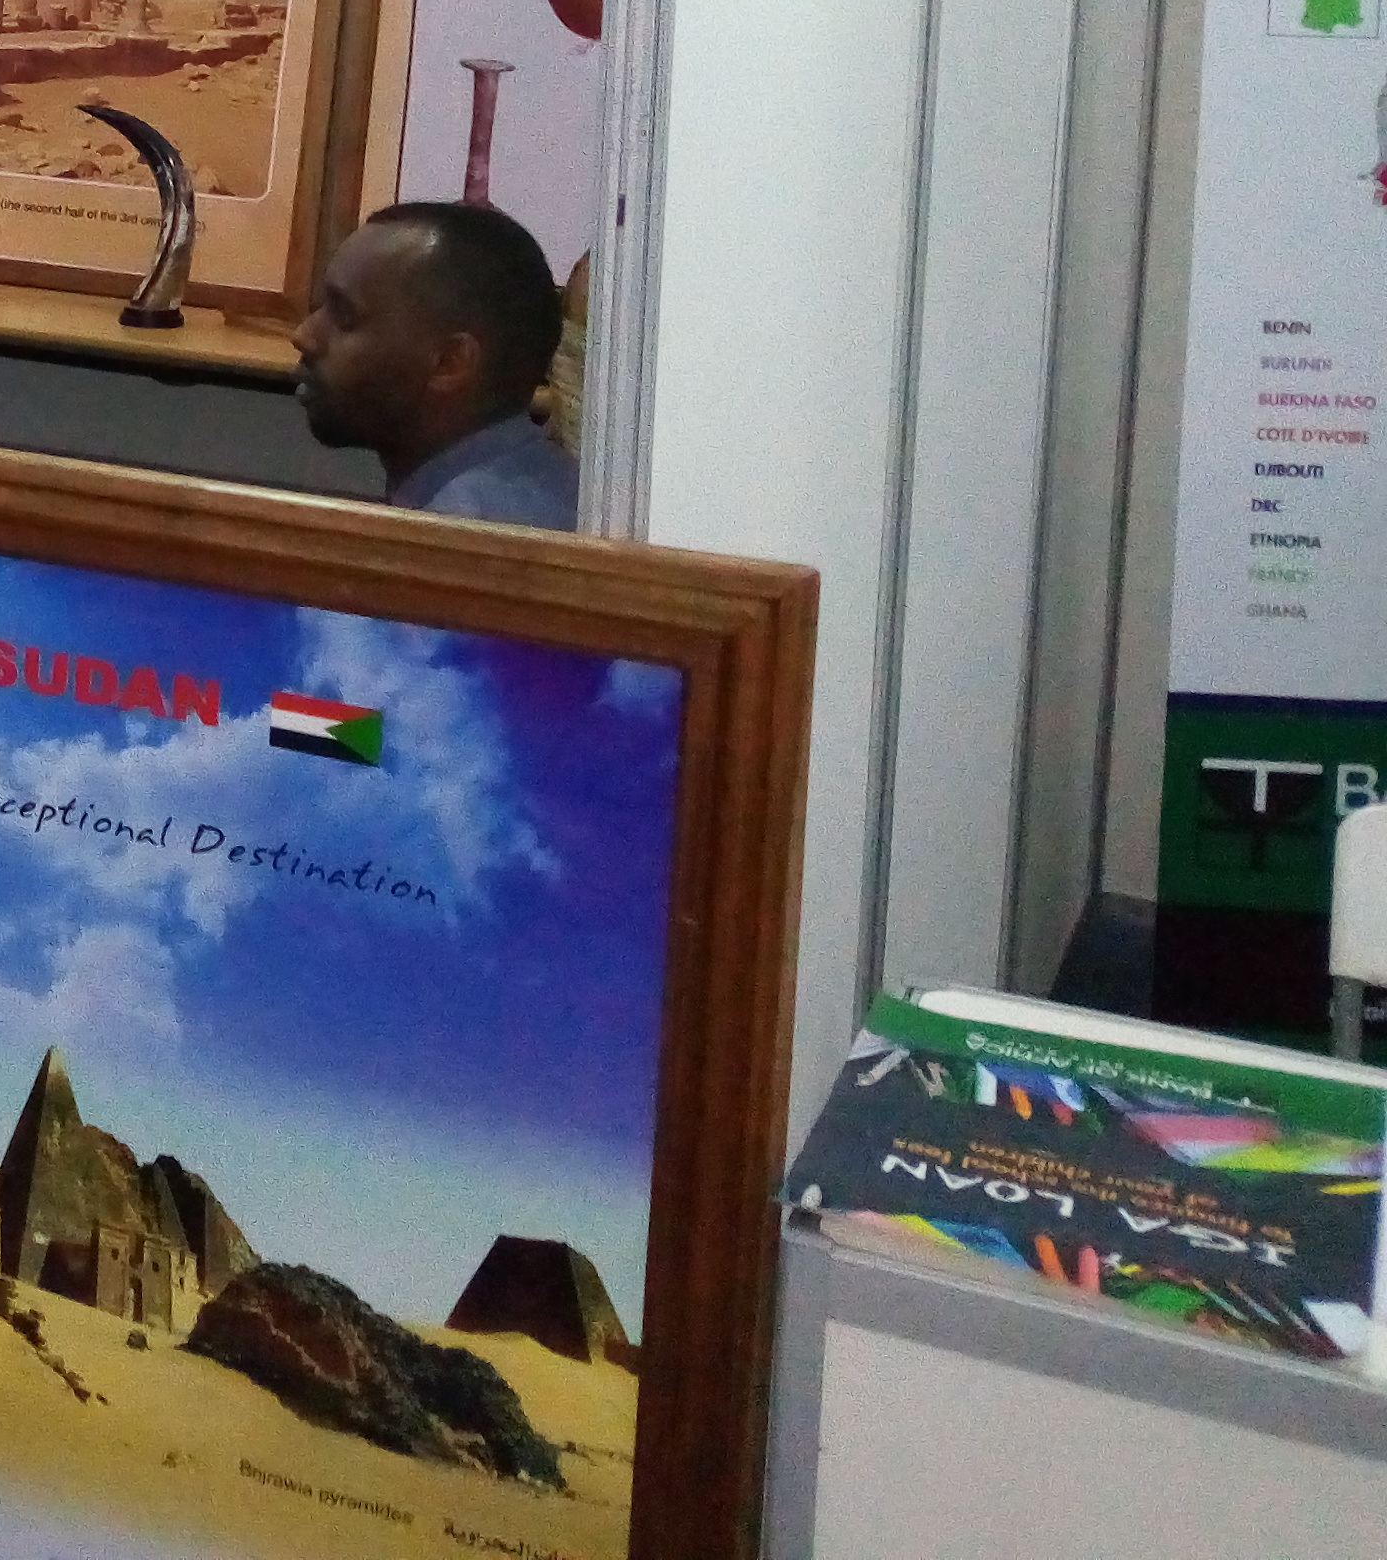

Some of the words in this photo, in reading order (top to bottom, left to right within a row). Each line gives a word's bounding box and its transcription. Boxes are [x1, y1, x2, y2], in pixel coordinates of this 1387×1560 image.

[24, 203, 62, 216] second
[65, 205, 84, 218] half
[87, 209, 97, 219] of
[1259, 393, 1329, 407] BURKINA
[1335, 395, 1376, 409] FASO
[190, 823, 438, 906] Destination
